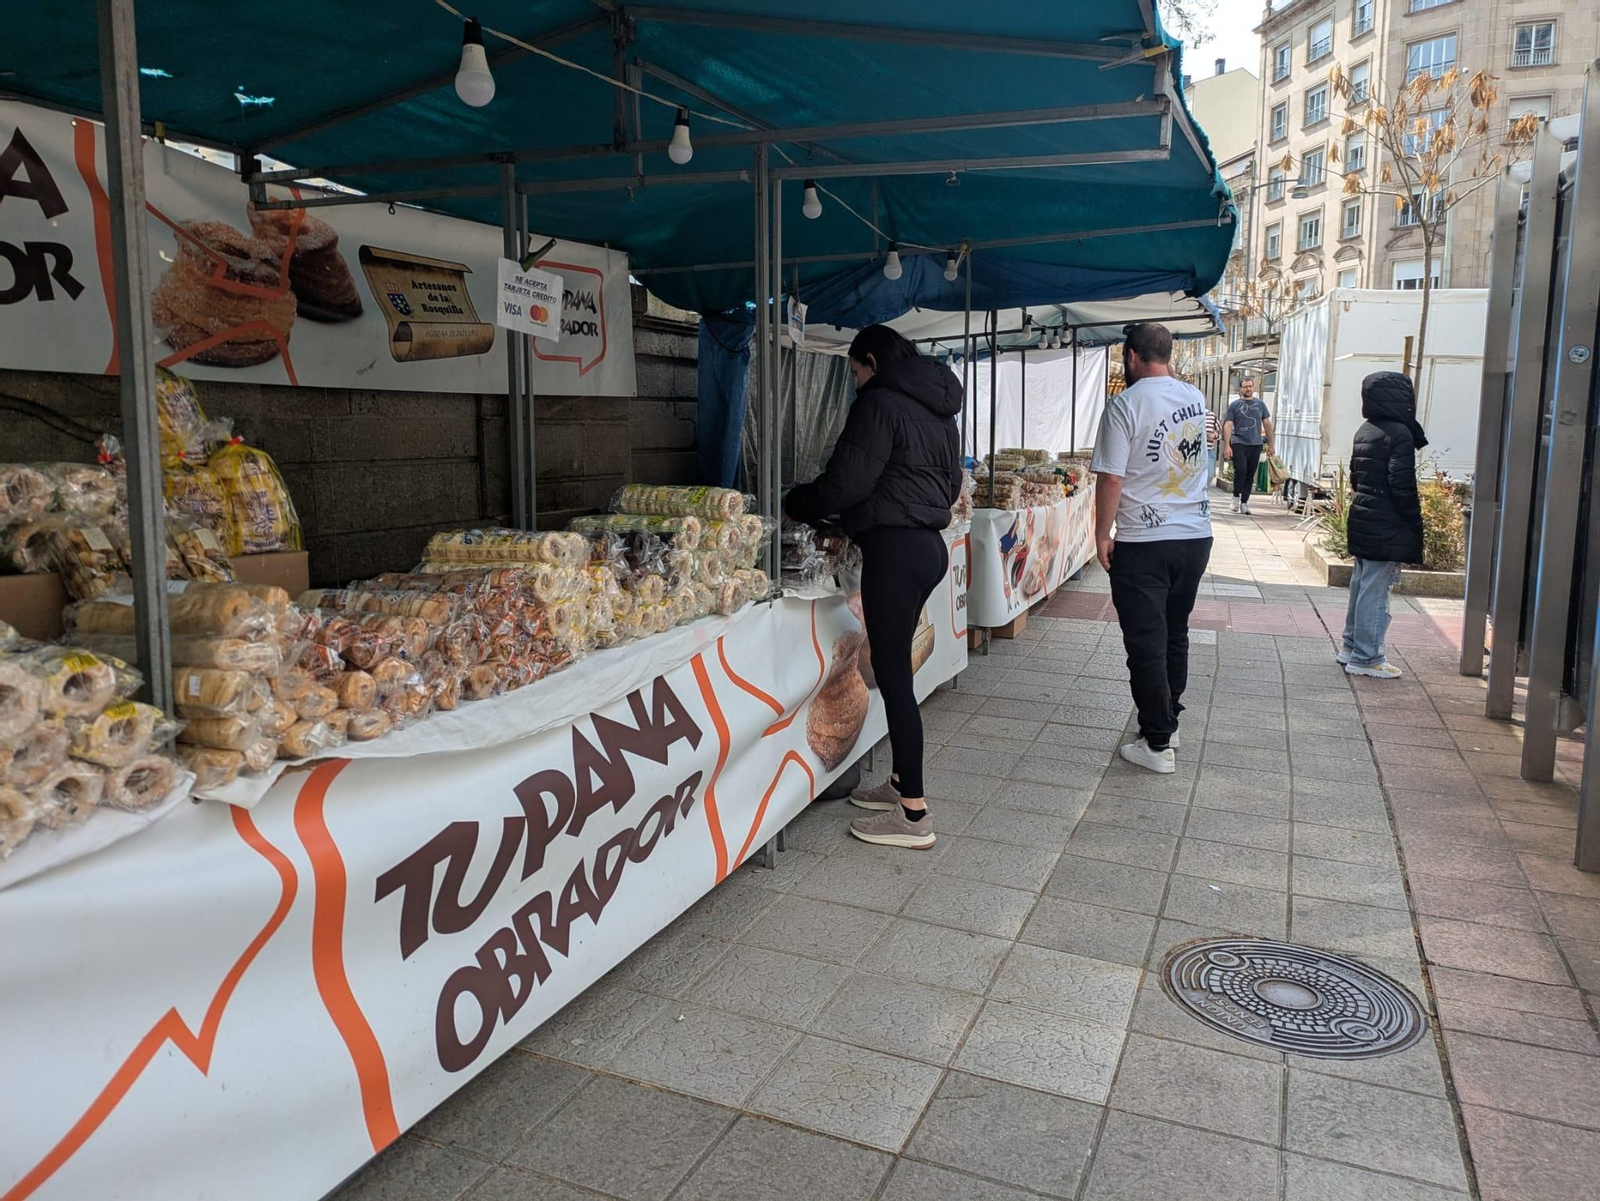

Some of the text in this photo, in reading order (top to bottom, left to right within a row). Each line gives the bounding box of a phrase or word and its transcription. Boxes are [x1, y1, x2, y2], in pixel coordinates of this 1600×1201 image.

[411, 280, 457, 292] Artesanos
[503, 282, 557, 303] TARJETA CREDITO
[514, 275, 547, 290] SE ACEPTA
[427, 293, 450, 303] de la
[421, 303, 464, 315] Rosquilla
[503, 301, 522, 317] VISA
[1145, 402, 1204, 463] JUST CHILL
[374, 674, 703, 961] TUPANA
[435, 769, 703, 1073] OBRADOR
[1195, 1000, 1246, 1030] UNION
[1208, 994, 1267, 1029] FENOSA
